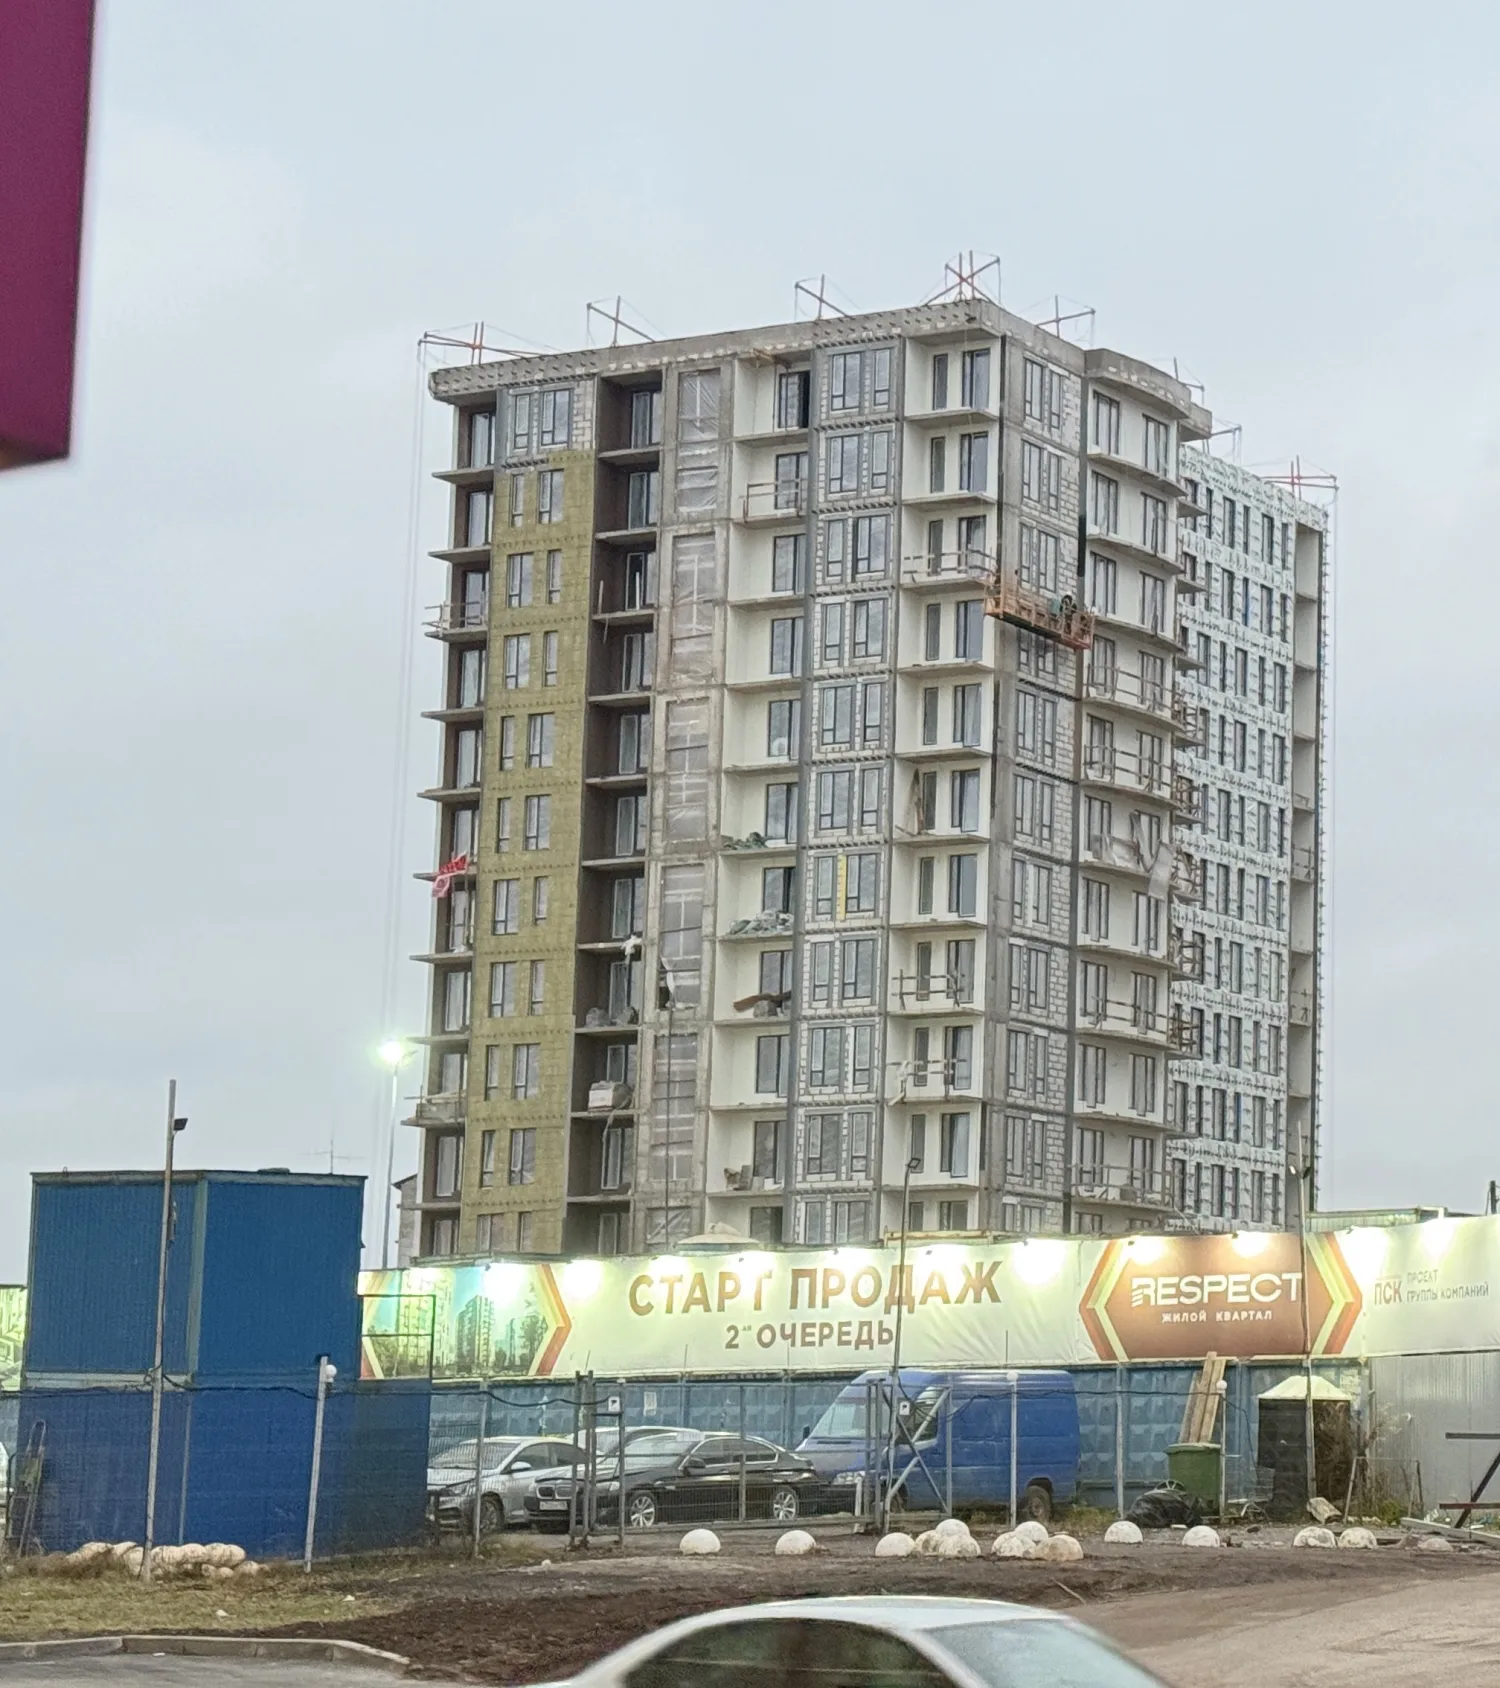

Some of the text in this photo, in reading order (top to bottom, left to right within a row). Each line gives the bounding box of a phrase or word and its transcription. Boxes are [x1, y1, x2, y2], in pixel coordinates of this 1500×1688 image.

[789, 1260, 1004, 1315] ПРОДАЖ
[1406, 1269, 1439, 1285] ПРОЕКТ
[1131, 1272, 1303, 1308] RESPECT
[1374, 1280, 1403, 1305] ПСК
[1406, 1281, 1489, 1303] ГРУППЫ КОМПАНИЙ
[1161, 1310, 1273, 1324] ЖИЛОЙ КВАРТАЛ
[756, 1320, 895, 1351] ОЧЕРЕДЬ
